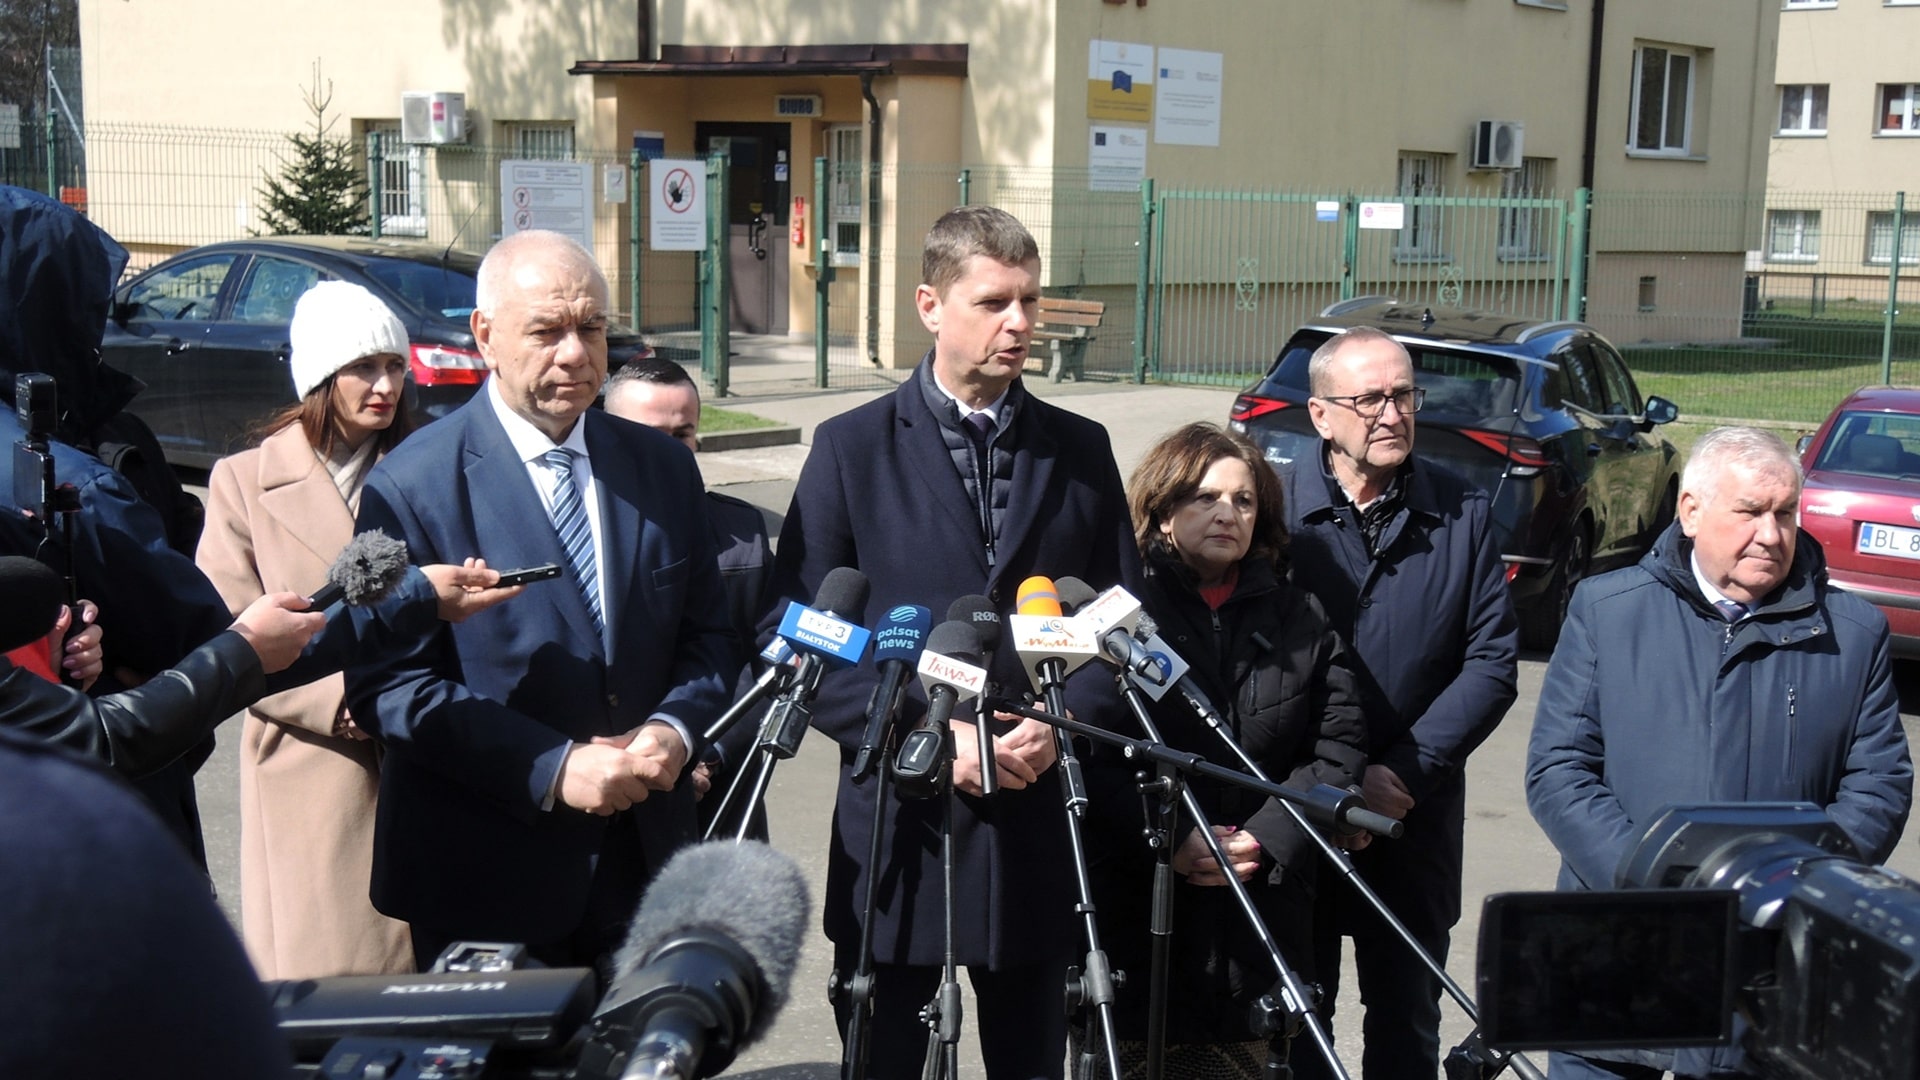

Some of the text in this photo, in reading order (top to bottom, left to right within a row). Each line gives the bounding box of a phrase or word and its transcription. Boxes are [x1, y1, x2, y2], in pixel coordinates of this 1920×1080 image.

[1875, 529, 1899, 550] BL
[1909, 534, 1920, 552] 8
[795, 630, 841, 652] BIAŁYSTOK
[877, 626, 920, 641] polsat
[879, 637, 915, 650] news
